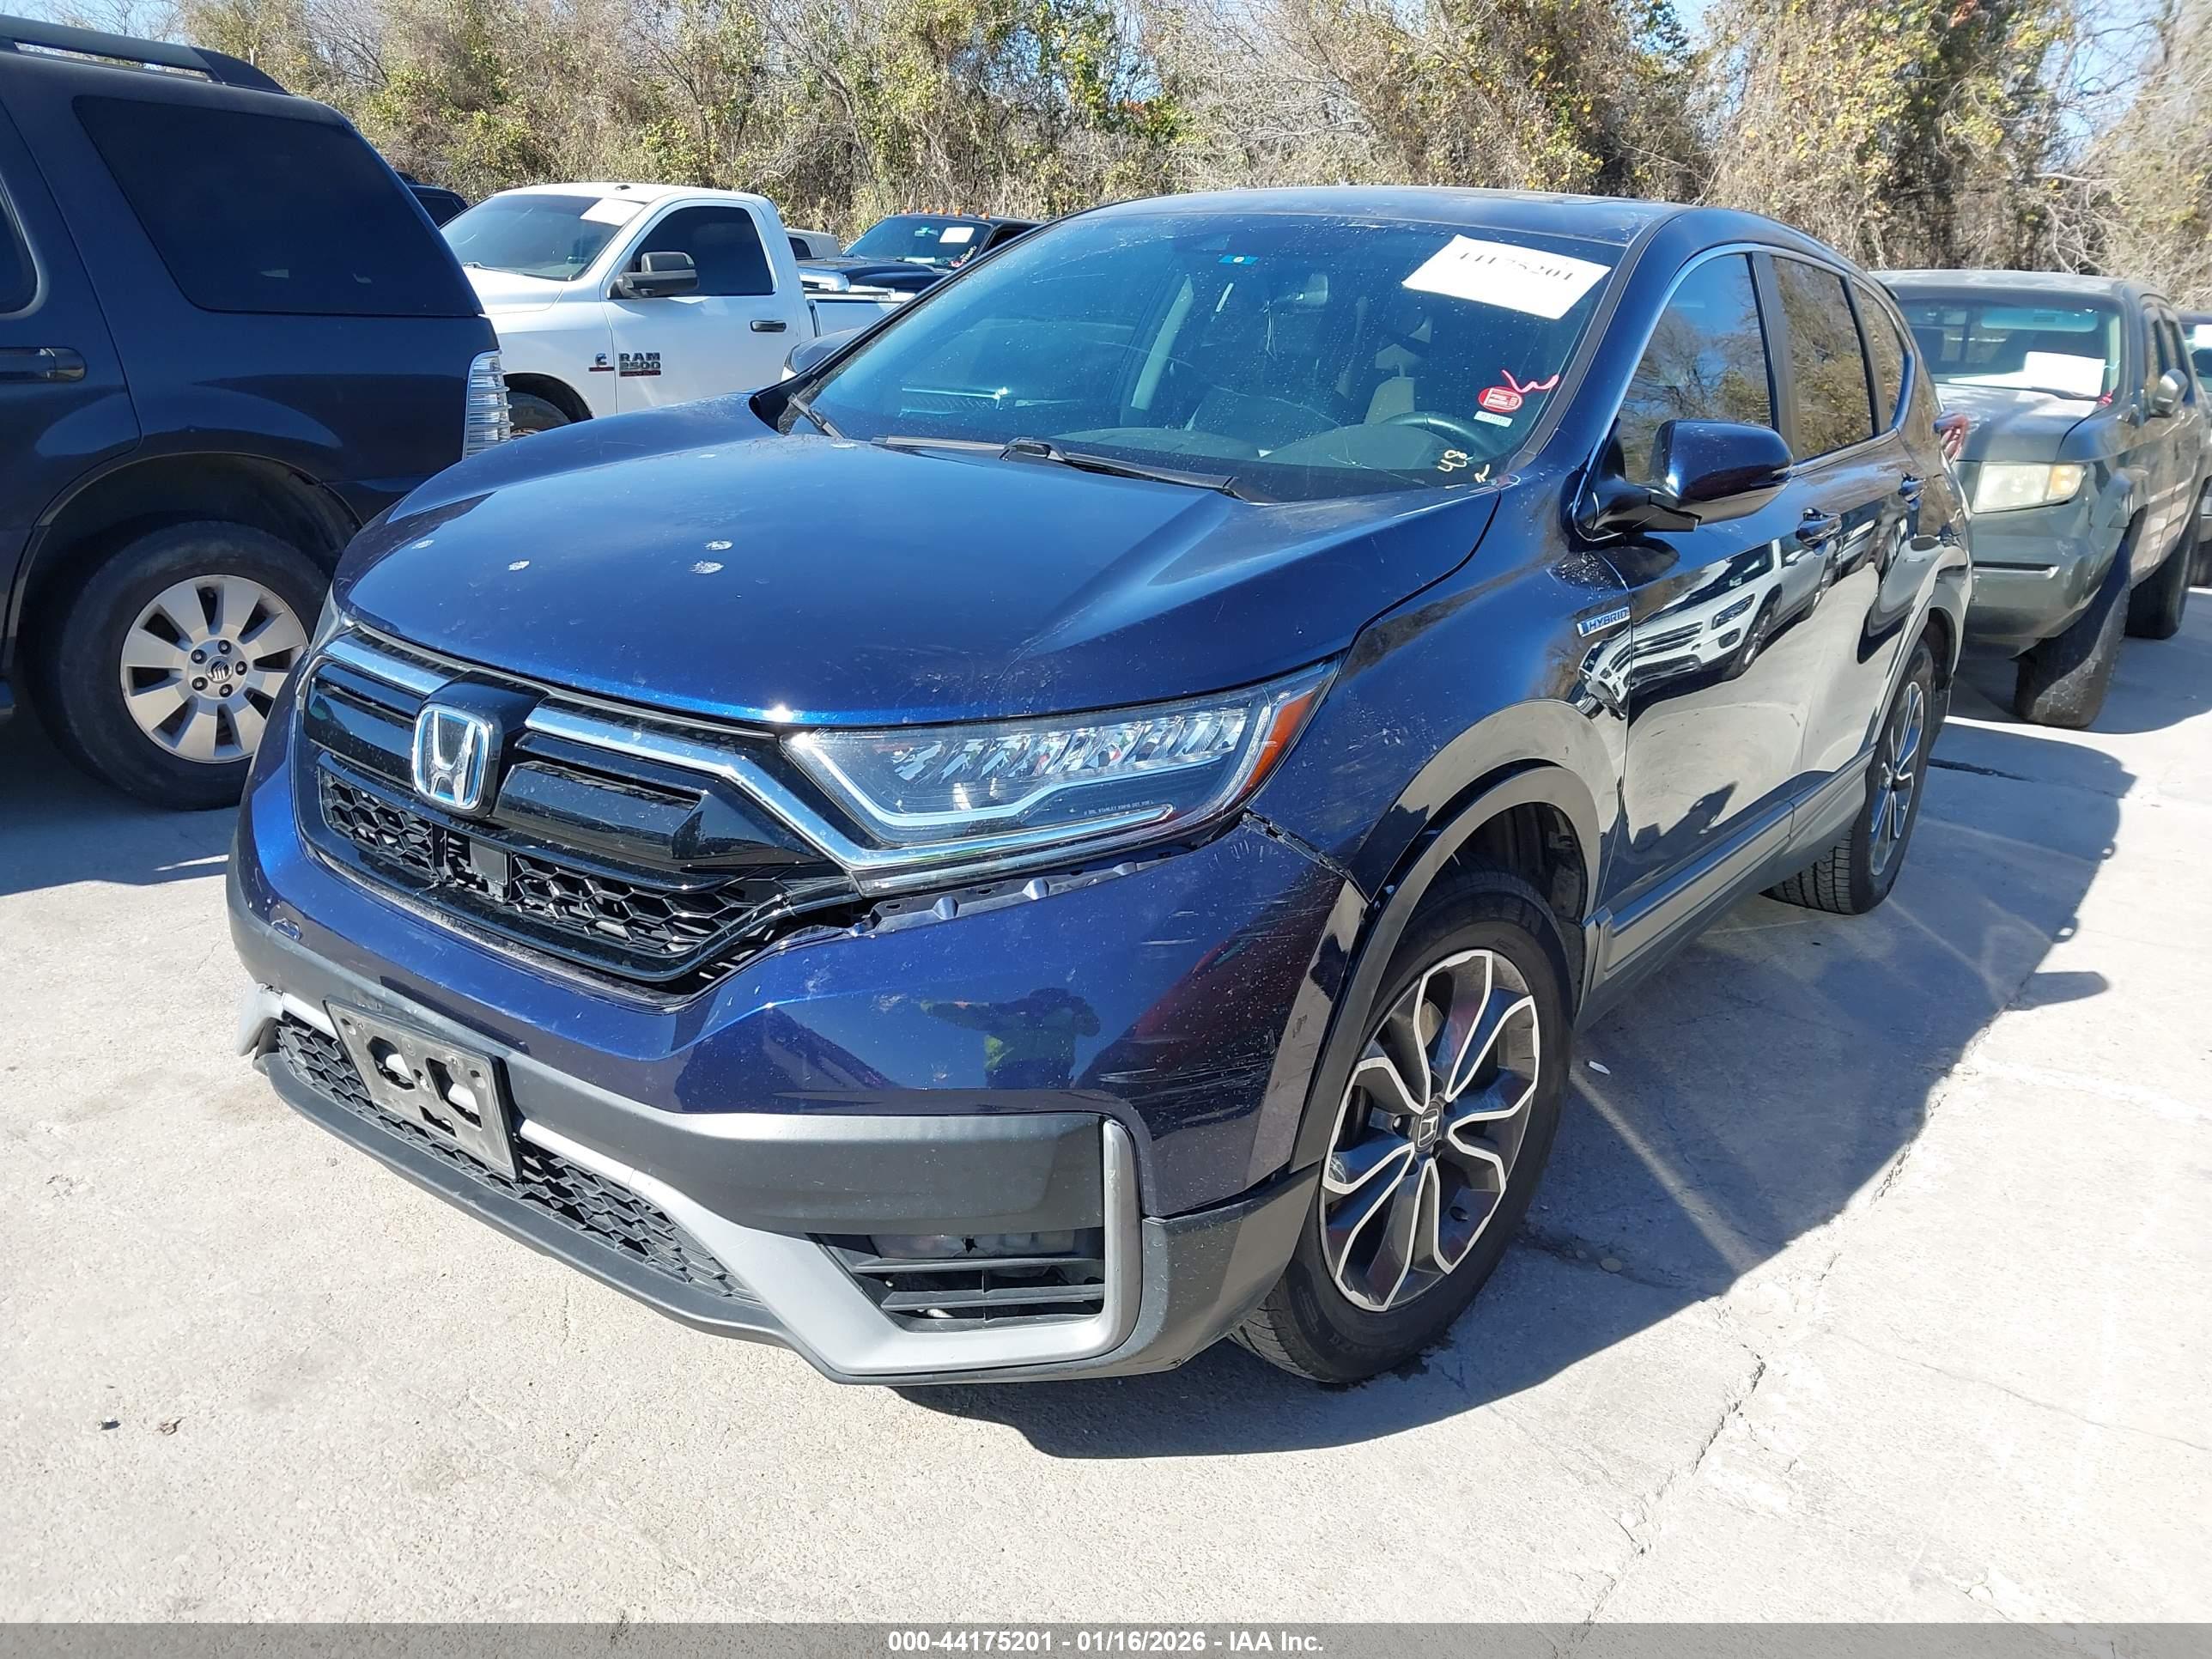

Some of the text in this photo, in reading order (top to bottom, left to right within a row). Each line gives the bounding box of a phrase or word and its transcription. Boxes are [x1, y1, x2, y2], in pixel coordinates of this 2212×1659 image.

[619, 353, 660, 362] RAM
[619, 362, 660, 370] 2500
[1589, 609, 1628, 631] HYBRID
